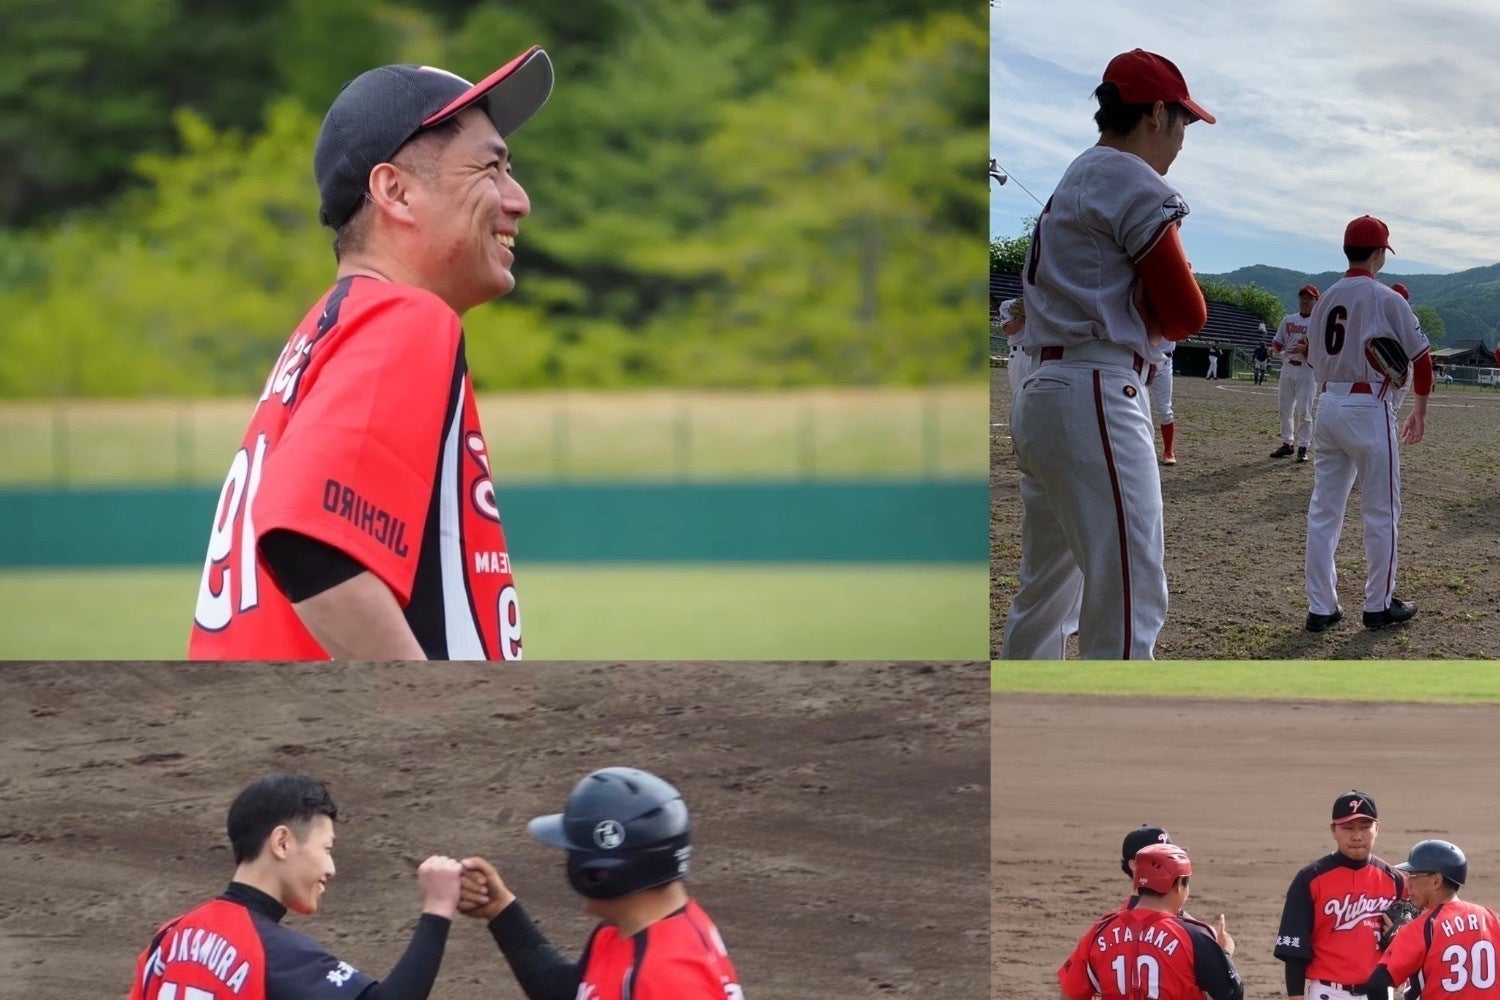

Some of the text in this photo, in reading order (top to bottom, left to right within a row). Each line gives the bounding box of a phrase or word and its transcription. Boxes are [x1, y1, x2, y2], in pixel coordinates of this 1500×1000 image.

[1324, 305, 1346, 355] 6
[1097, 926, 1180, 957] S.TAAKA
[1440, 940, 1496, 993] 30
